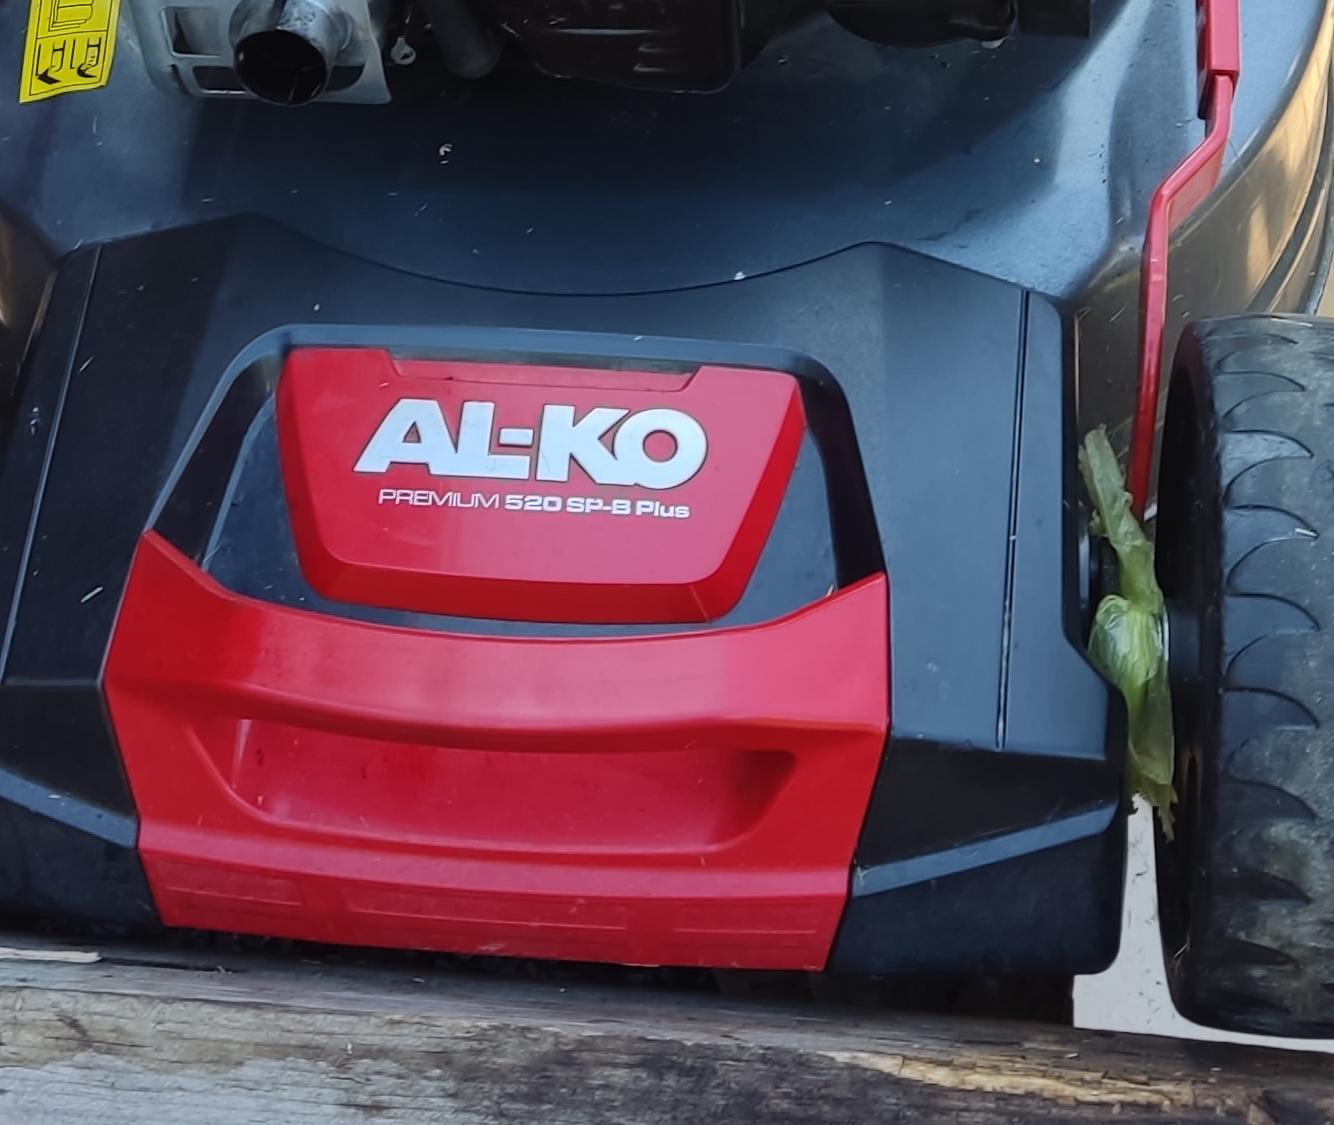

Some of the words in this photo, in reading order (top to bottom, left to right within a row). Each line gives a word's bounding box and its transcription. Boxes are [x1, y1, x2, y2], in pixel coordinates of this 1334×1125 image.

[353, 397, 709, 490] AL-KO
[378, 488, 500, 510] PREMIUM
[504, 494, 563, 513] 520
[566, 497, 631, 516] SP-B
[635, 501, 691, 519] Plus
